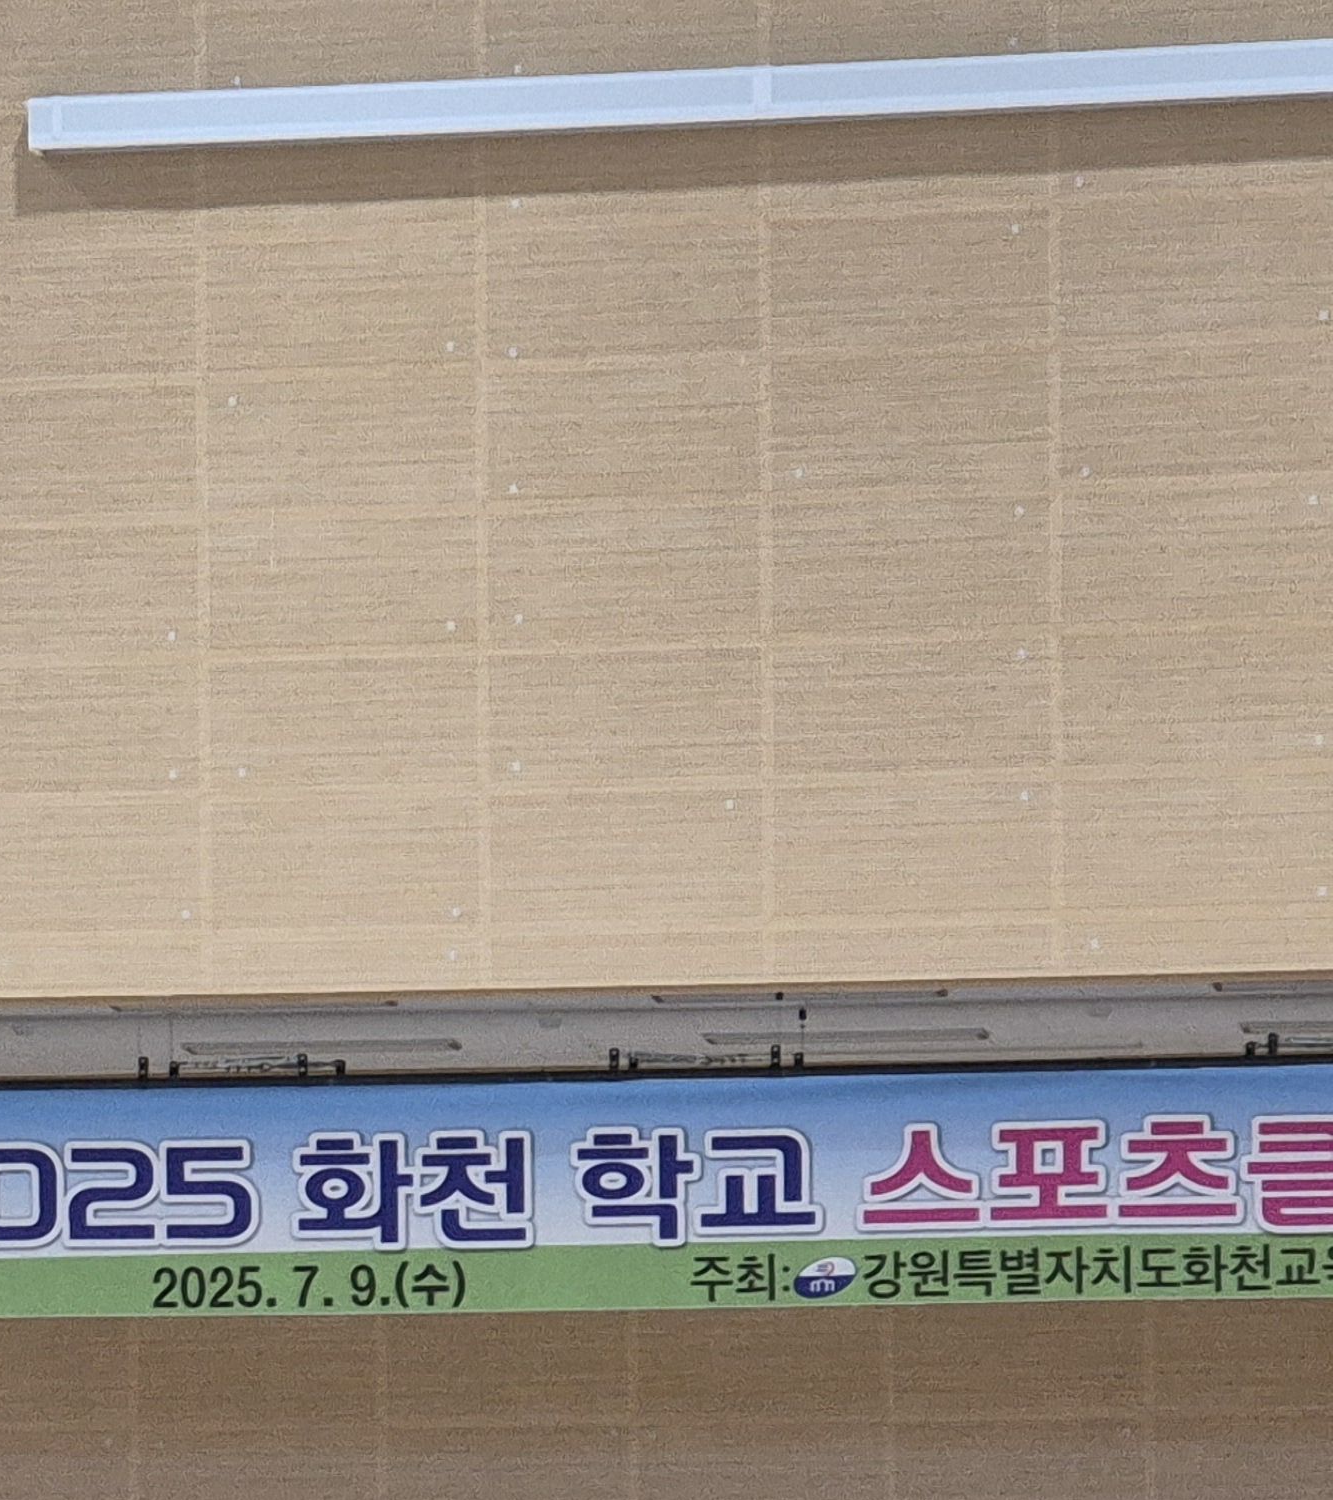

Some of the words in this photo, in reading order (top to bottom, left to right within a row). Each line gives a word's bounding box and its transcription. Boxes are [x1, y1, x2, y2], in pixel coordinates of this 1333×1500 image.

[296, 1132, 528, 1244] 화천
[576, 1130, 819, 1242] 학교
[861, 1118, 1333, 1228] 스포츠클
[152, 1266, 277, 1308] 2025.
[690, 1255, 791, 1301] 주최:
[862, 1243, 1333, 1299] 강원특별자치도화천교
